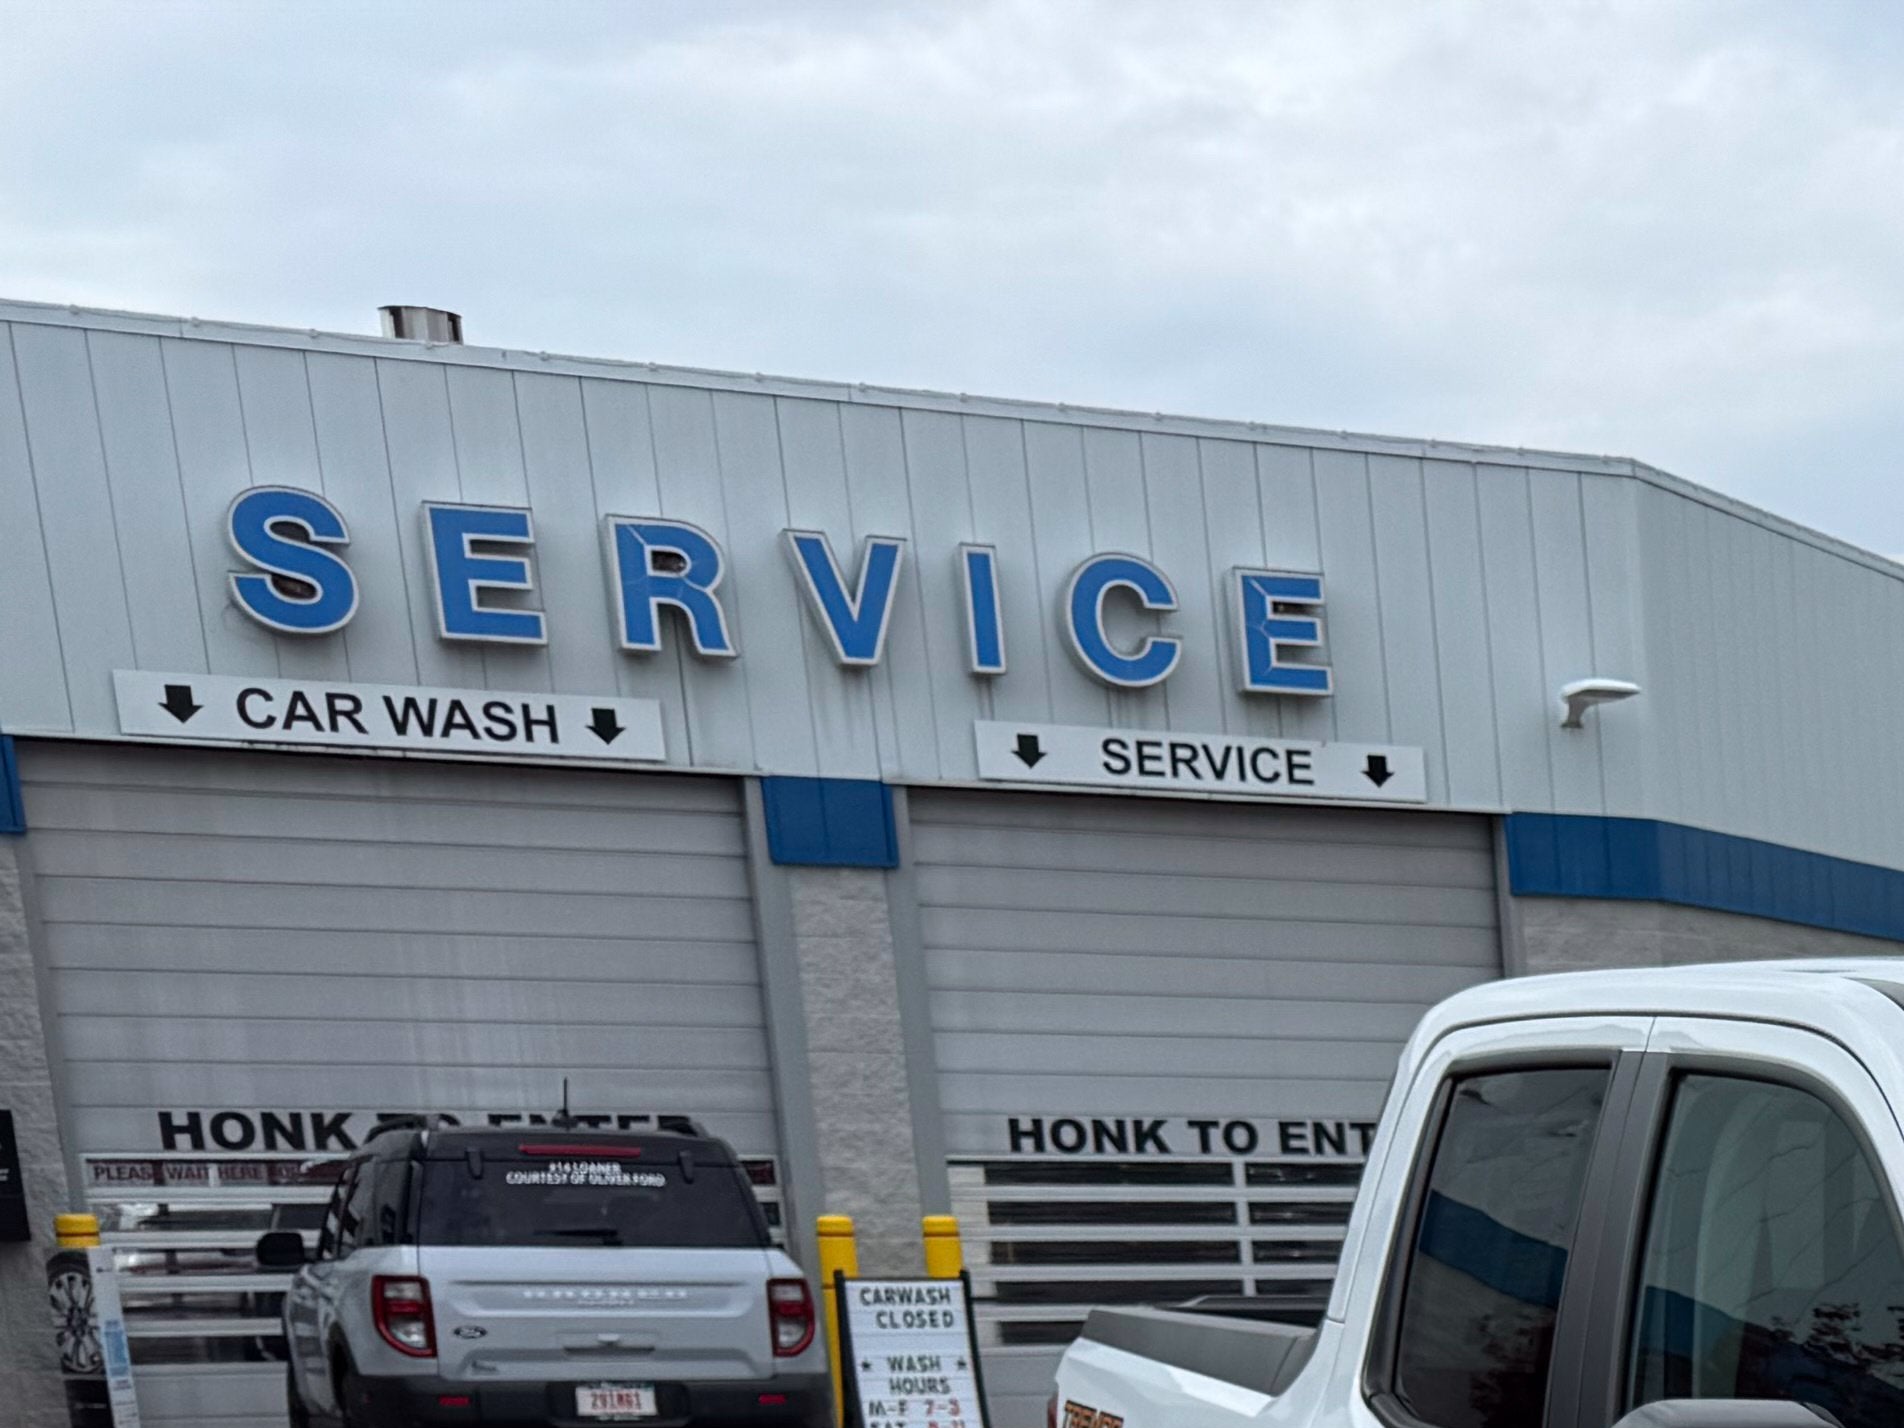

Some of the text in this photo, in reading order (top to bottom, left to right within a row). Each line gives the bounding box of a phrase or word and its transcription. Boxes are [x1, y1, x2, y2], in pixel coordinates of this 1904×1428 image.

[226, 483, 1334, 698] SERVICE
[235, 686, 561, 745] CAR WASH
[1100, 736, 1316, 786] SERVICE
[157, 1111, 359, 1151] HONK
[1007, 1118, 1172, 1154] HONK
[1187, 1120, 1259, 1155] TO
[94, 1164, 160, 1181] PLEAS
[858, 1286, 953, 1307] CARWASH
[875, 1309, 954, 1330] CLOSED
[886, 1354, 942, 1374] WASH
[888, 1376, 951, 1395] HOURS
